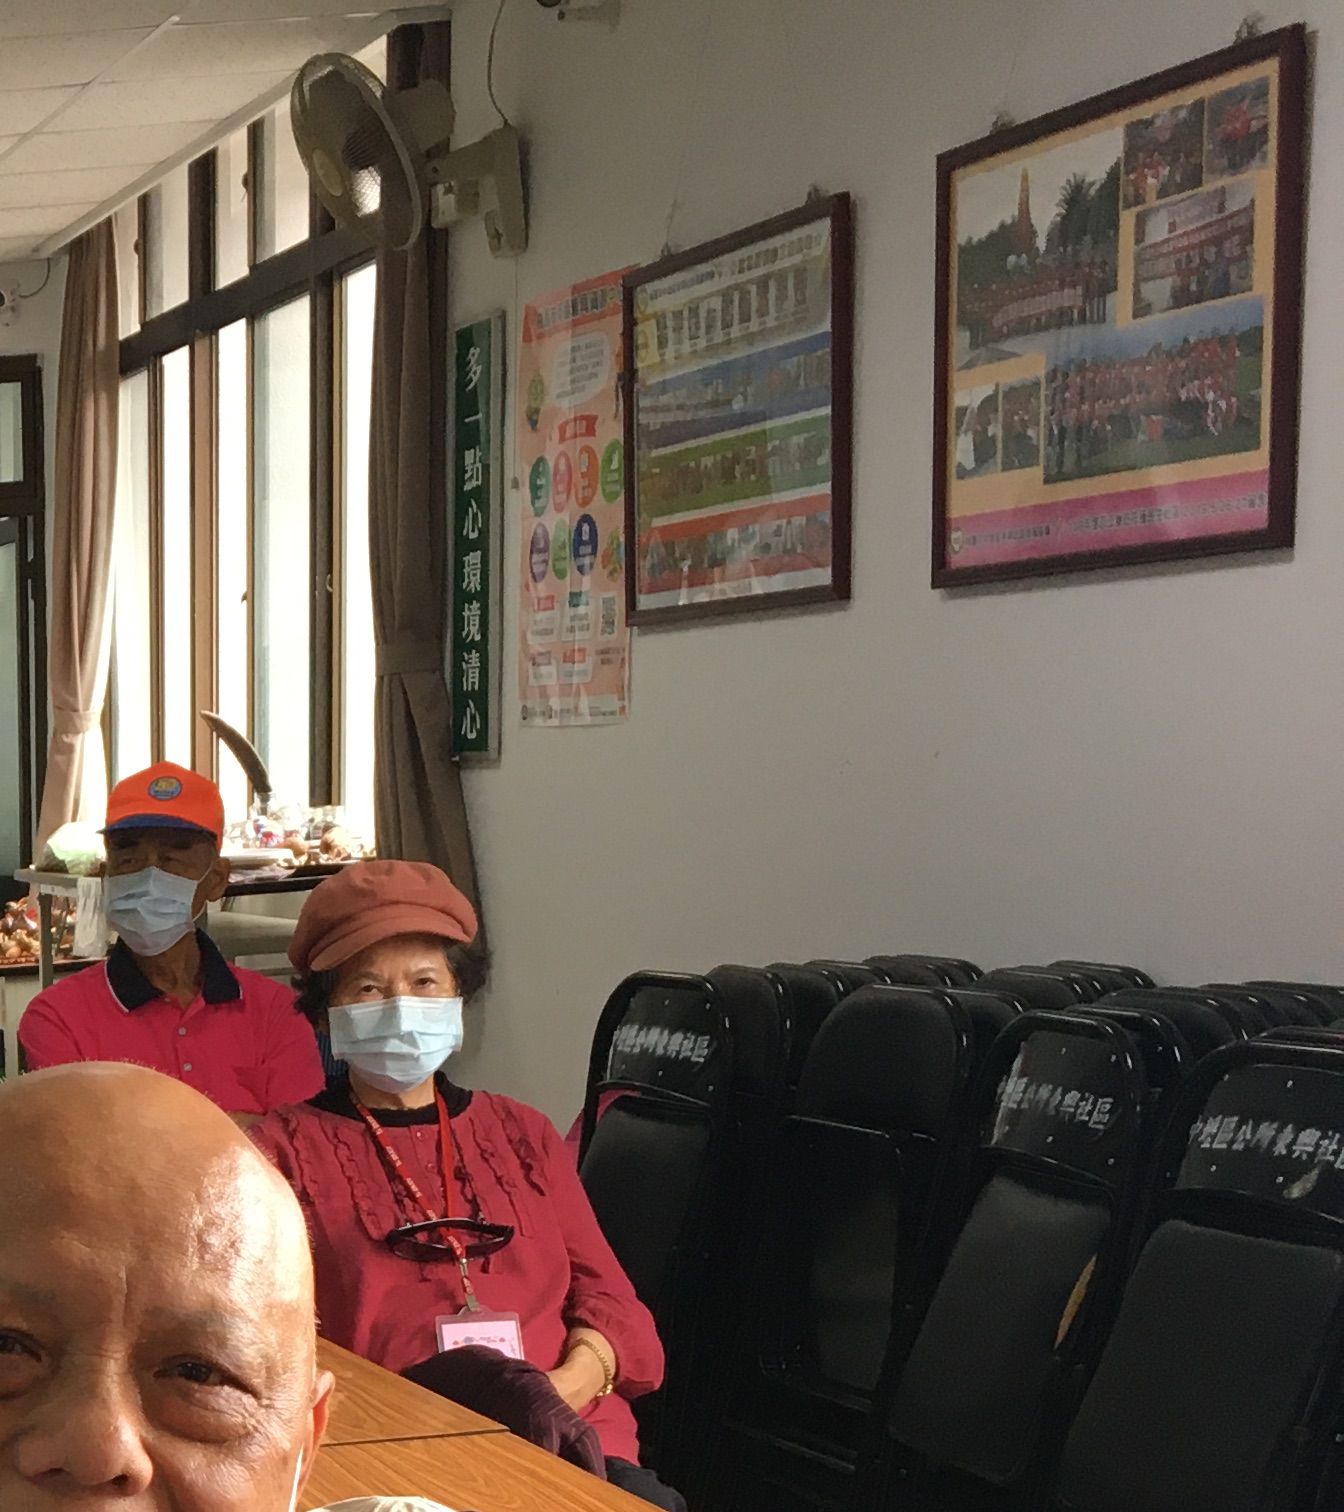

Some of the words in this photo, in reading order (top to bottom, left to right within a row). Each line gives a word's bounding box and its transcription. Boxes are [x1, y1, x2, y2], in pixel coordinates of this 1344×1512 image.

[461, 345, 483, 739] 多一點心環境清心
